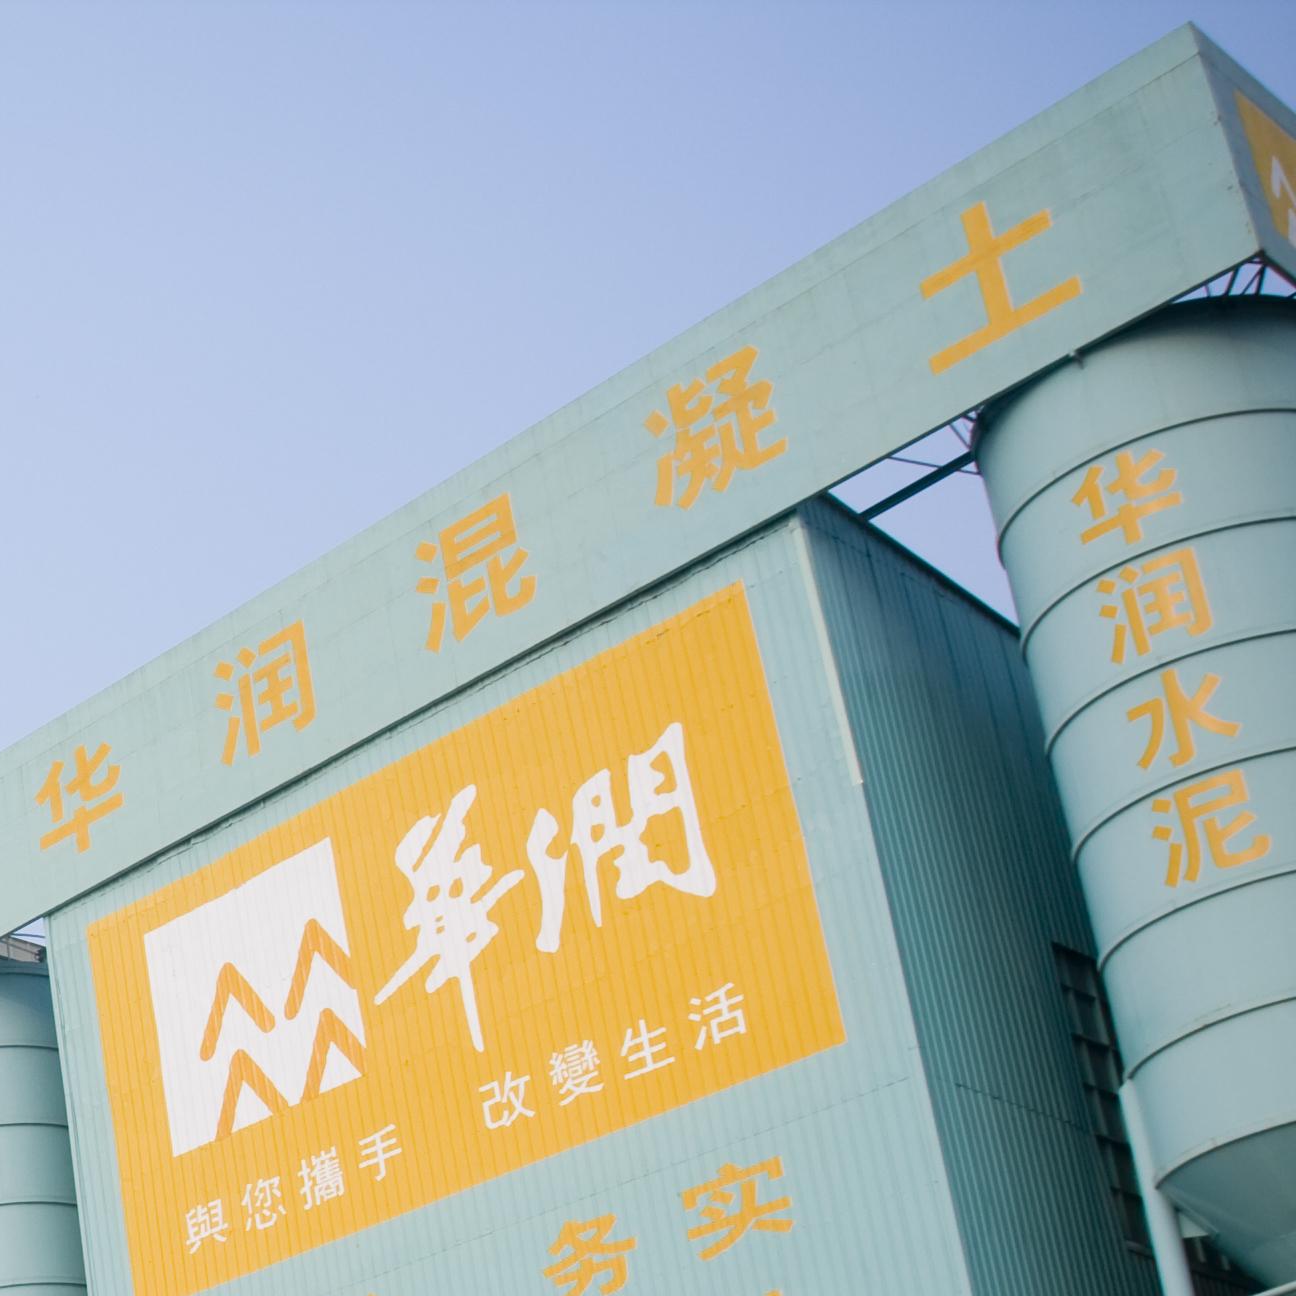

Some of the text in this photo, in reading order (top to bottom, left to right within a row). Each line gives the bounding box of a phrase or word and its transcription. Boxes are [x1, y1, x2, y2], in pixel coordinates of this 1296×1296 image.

[35, 202, 1082, 856] 华润混凝土
[1072, 449, 1271, 887] 华润水泥
[478, 982, 748, 1131] 改變生活
